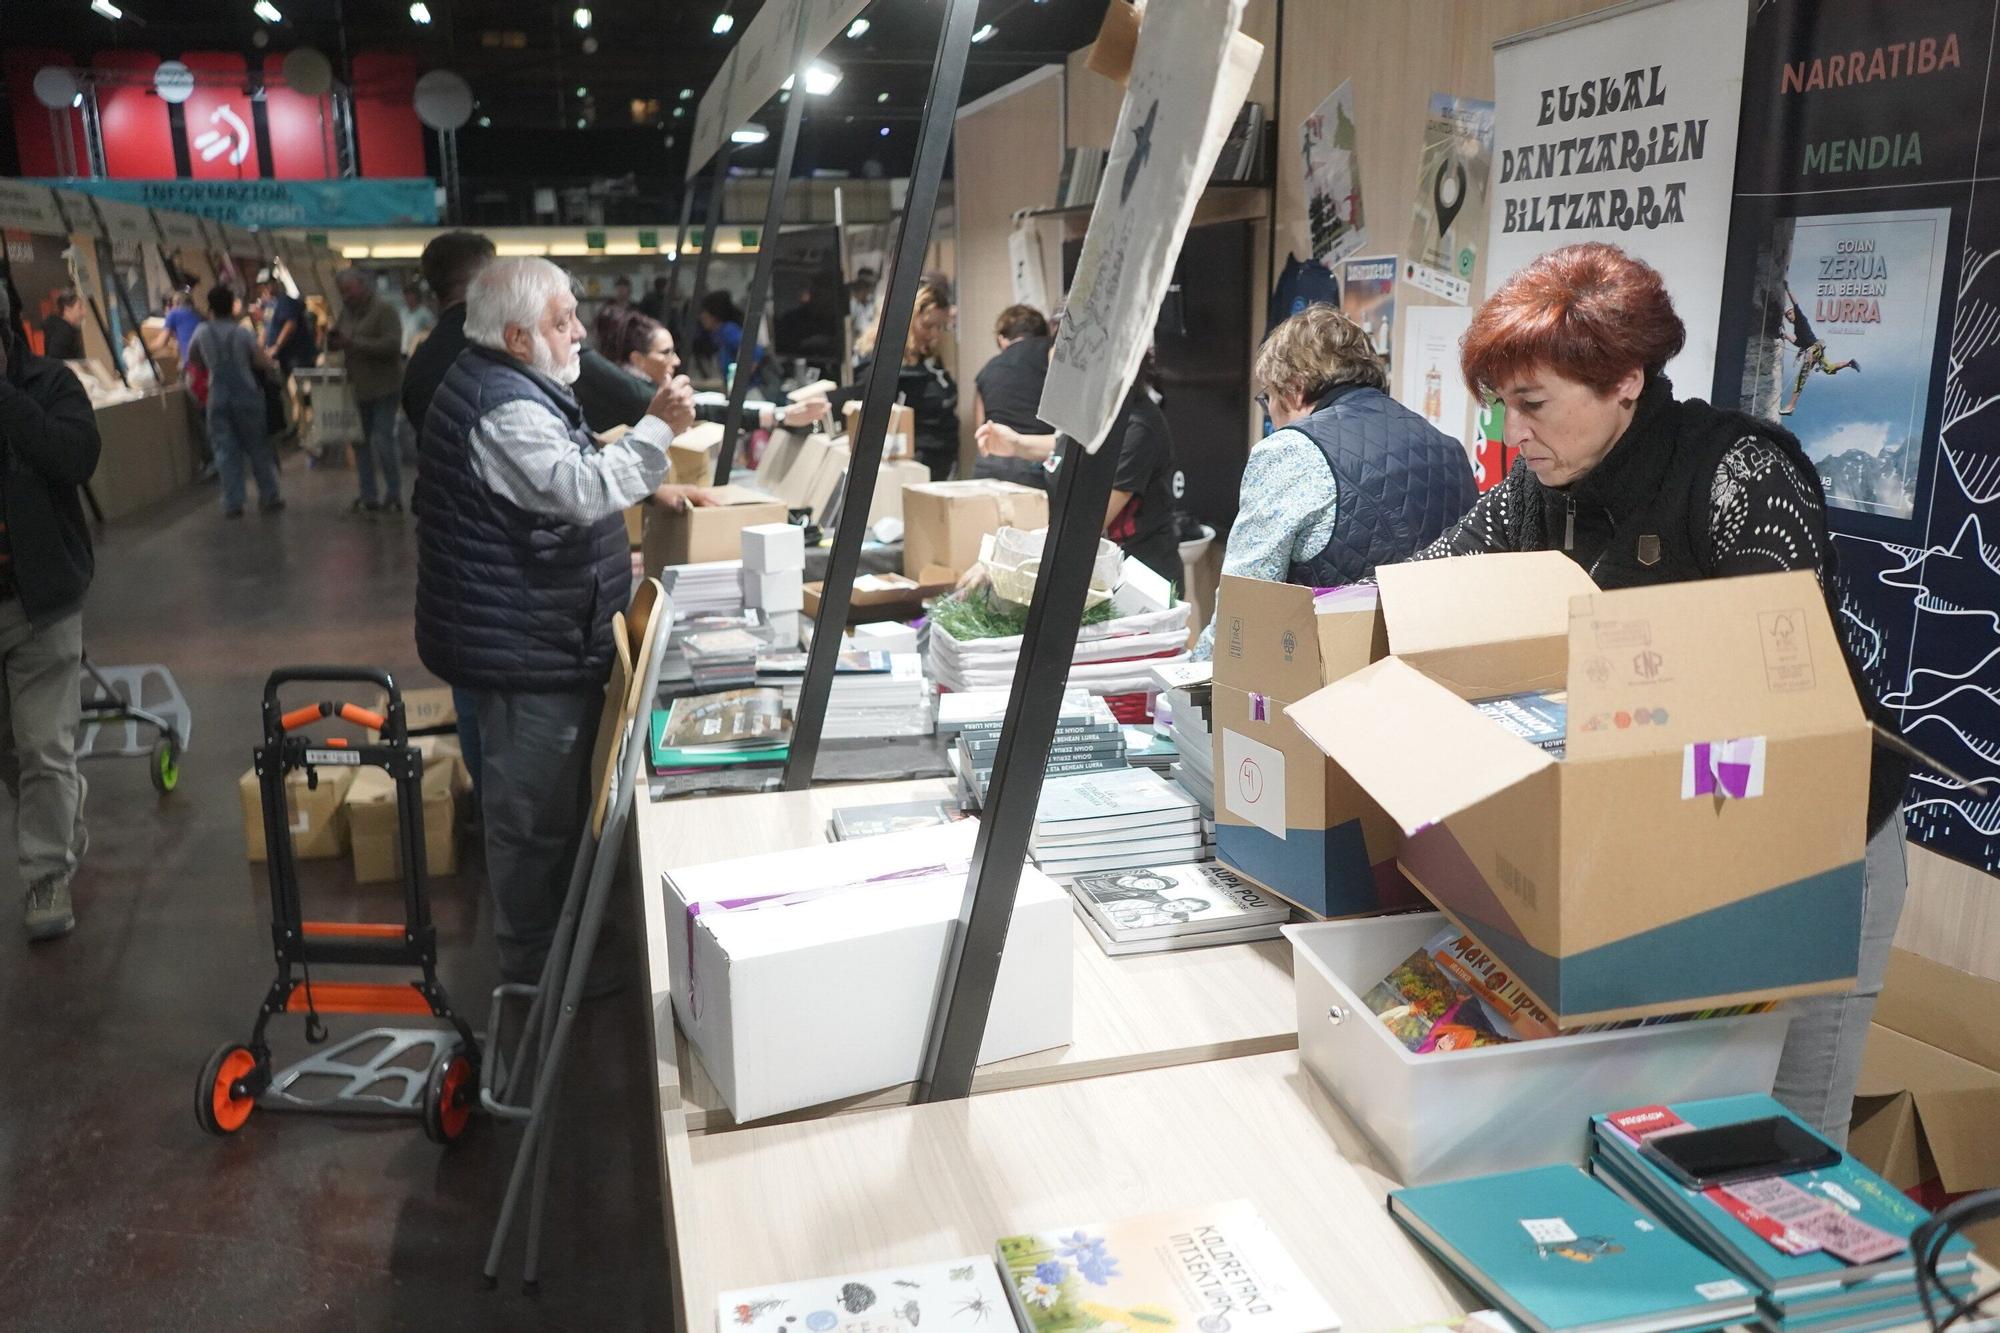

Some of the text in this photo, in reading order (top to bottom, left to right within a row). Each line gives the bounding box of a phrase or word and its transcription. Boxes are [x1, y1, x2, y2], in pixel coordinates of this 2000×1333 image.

[1780, 32, 1961, 95] NARRATIBA
[1536, 64, 1667, 127] EUSKAL
[1802, 131, 1923, 176] MENDIA
[1837, 240, 1875, 254] GOIAN
[1818, 254, 1888, 281] ZERUA
[1816, 282, 1887, 297] ETA BEHEAN
[1815, 298, 1882, 324] LURRA
[1208, 867, 1269, 908] AUPA POU
